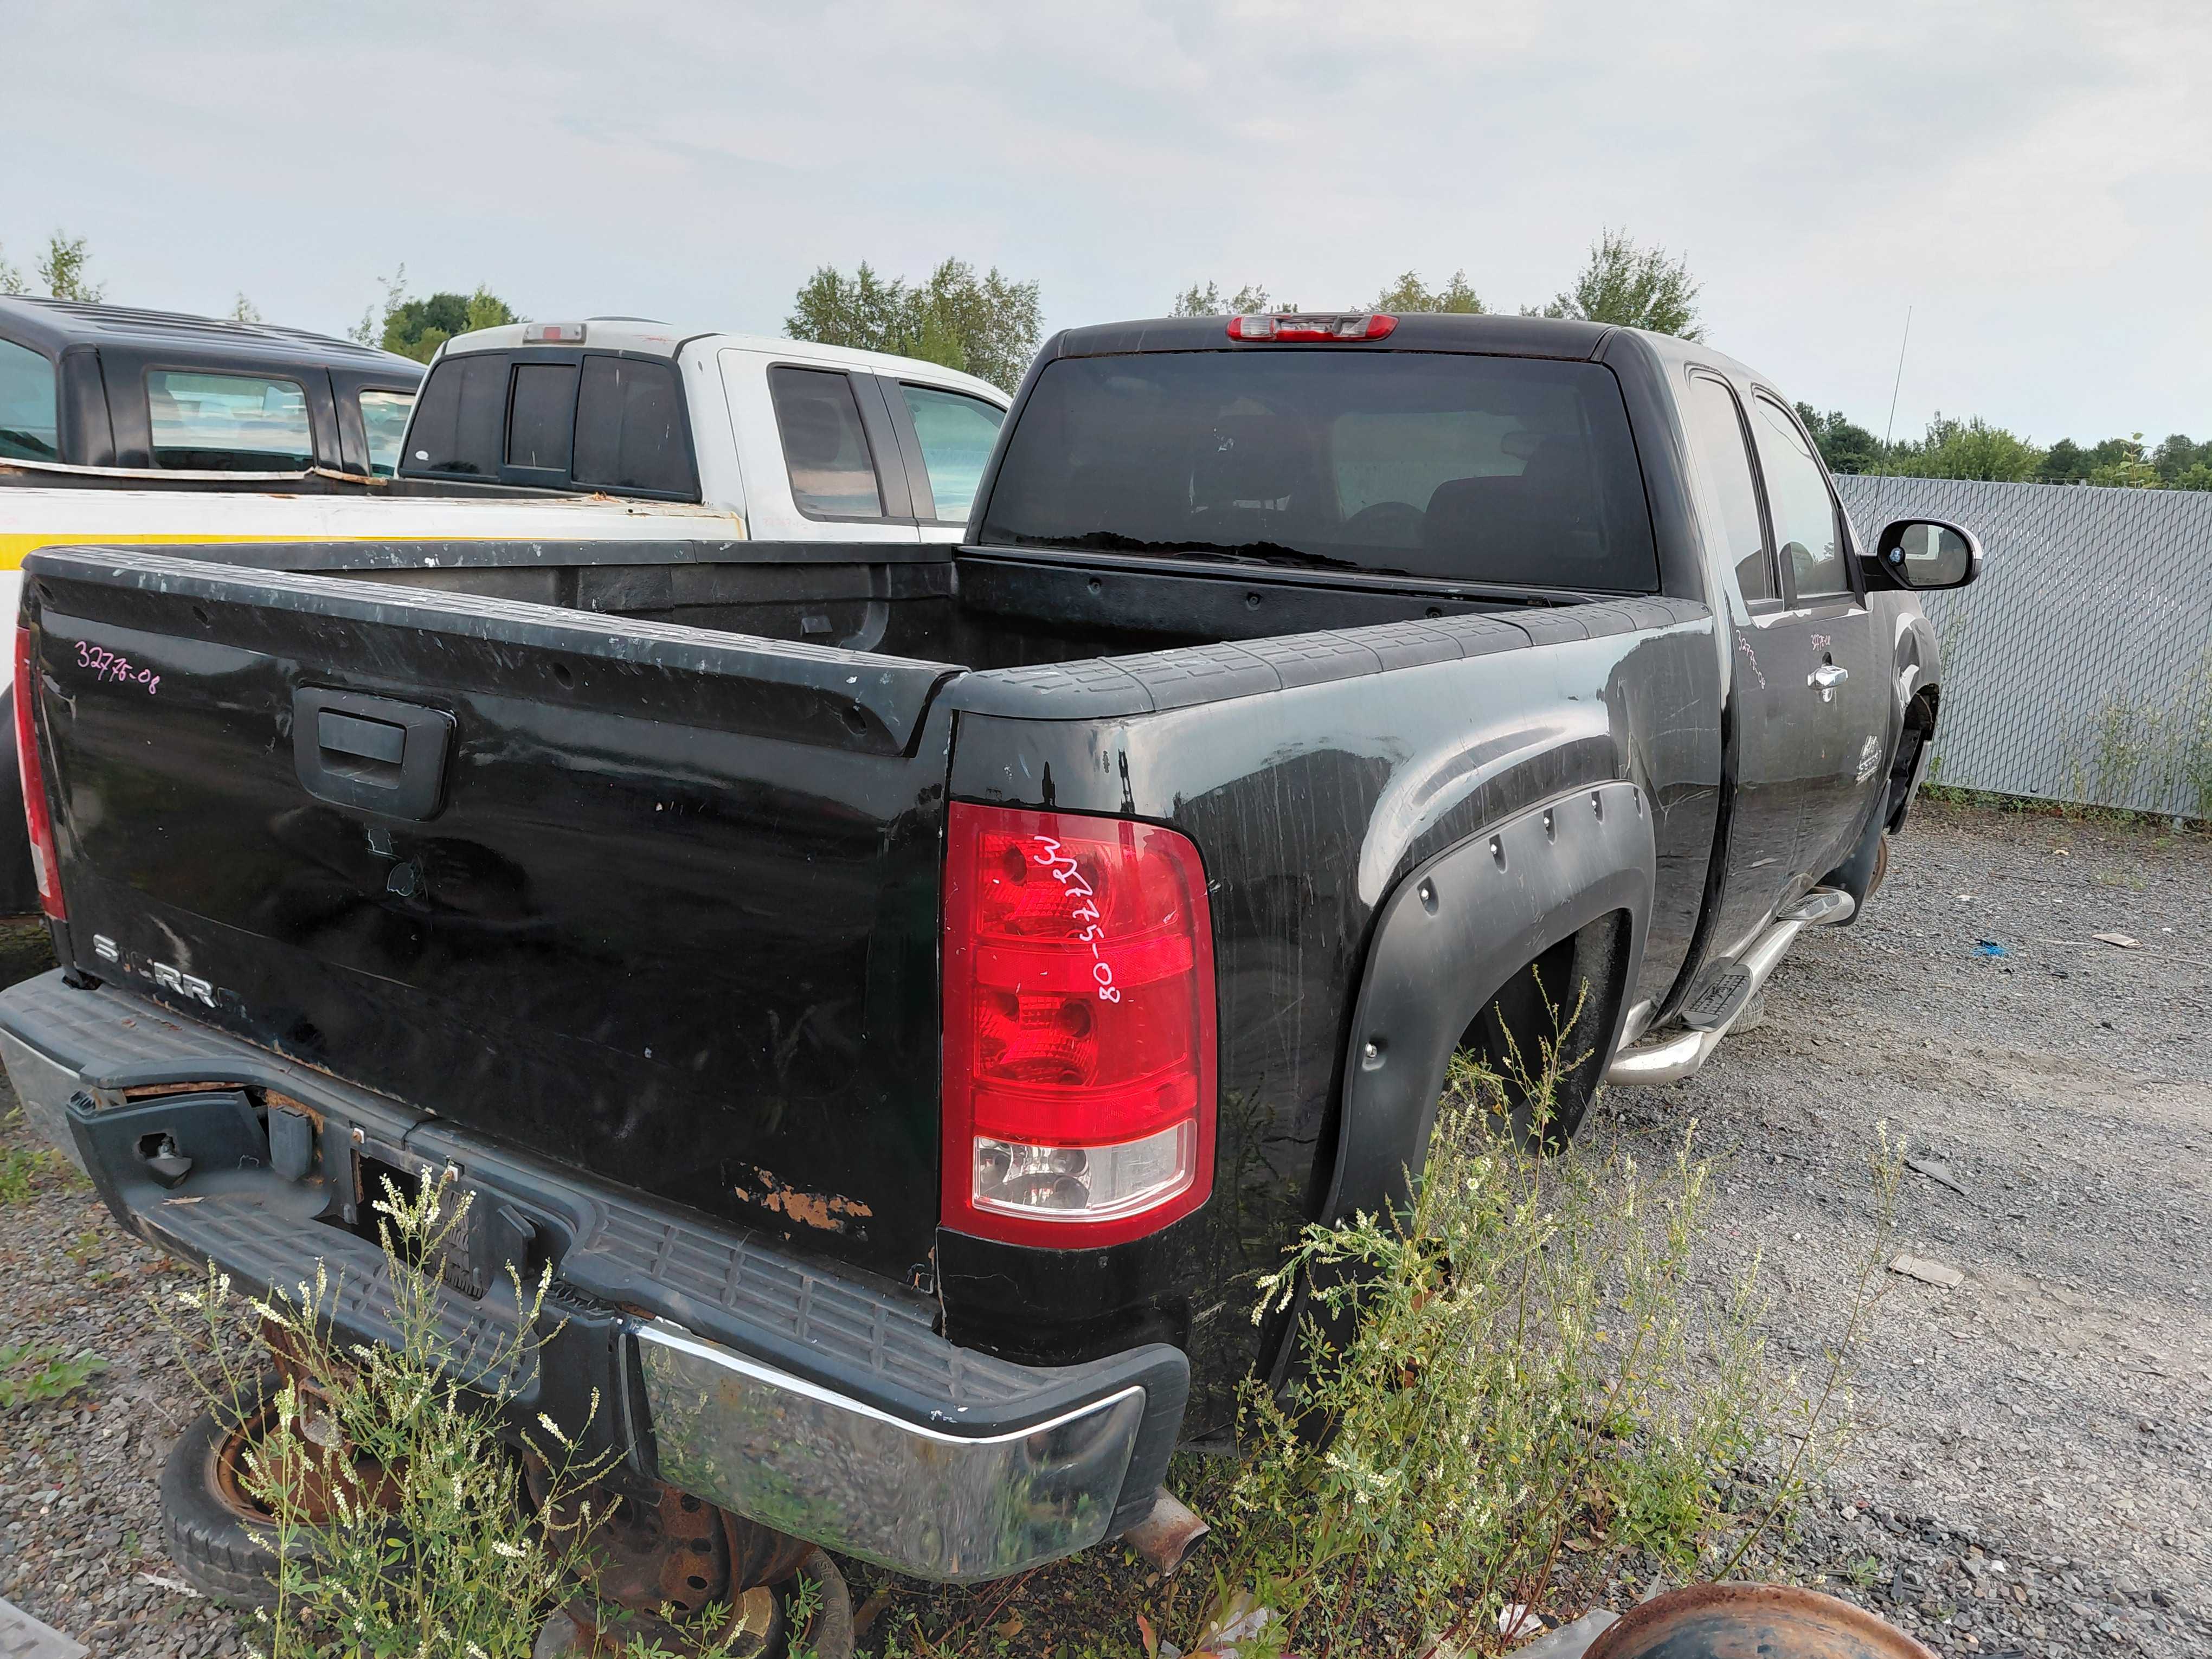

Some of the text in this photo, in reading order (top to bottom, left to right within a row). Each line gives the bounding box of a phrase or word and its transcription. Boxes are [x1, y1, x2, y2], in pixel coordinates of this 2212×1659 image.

[74, 640, 160, 695] 32775-08
[1736, 629, 1766, 690] 32775-08
[1033, 835, 1121, 1004] 32775-08
